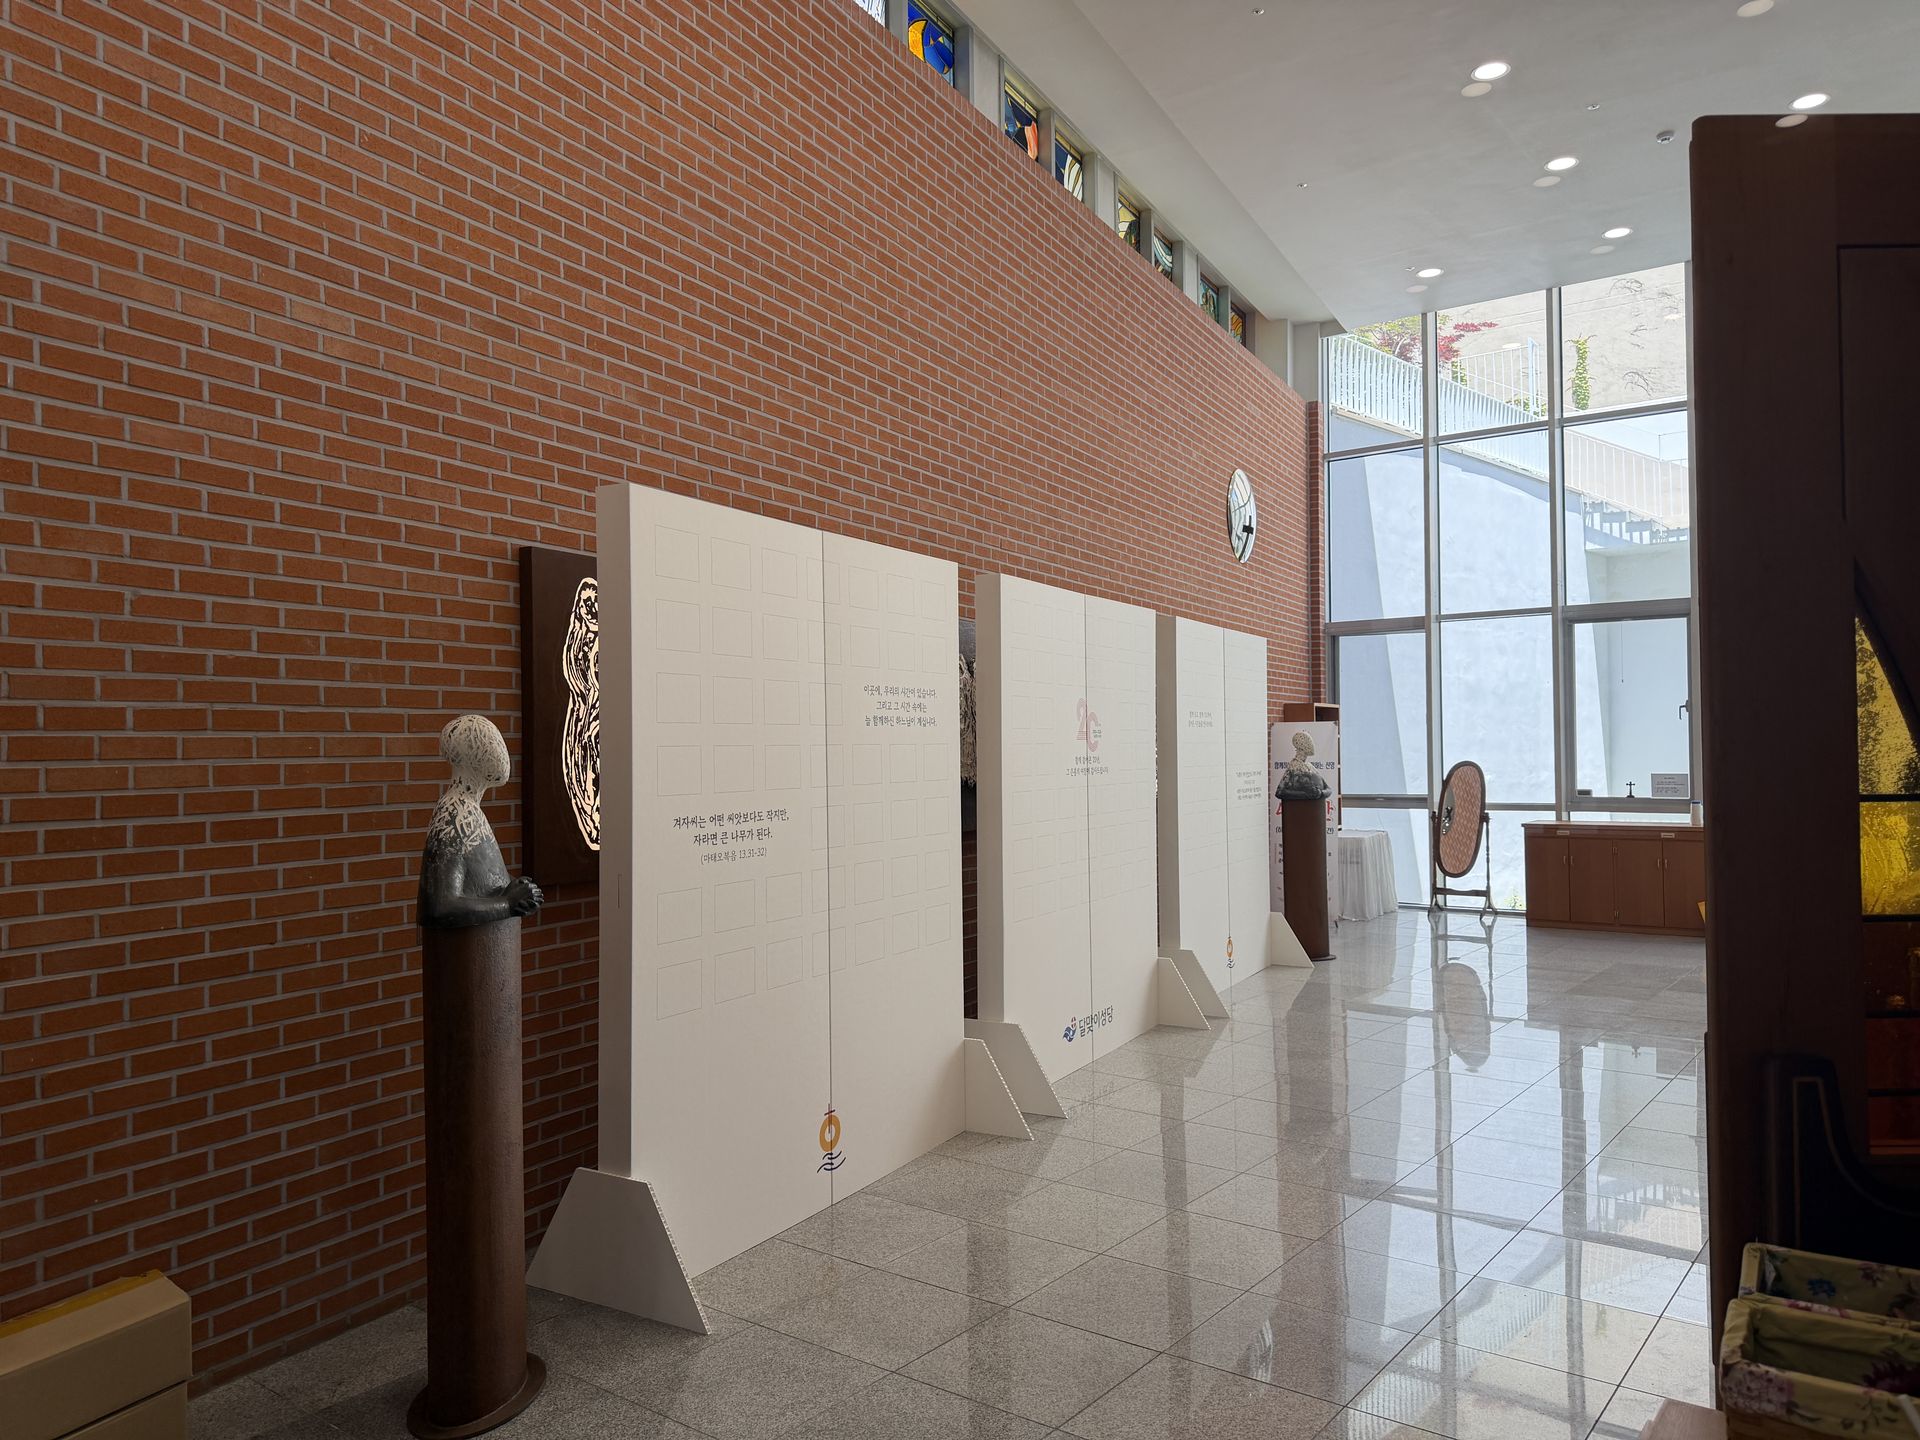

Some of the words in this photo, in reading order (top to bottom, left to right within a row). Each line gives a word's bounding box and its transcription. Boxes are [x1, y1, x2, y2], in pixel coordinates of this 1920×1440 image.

[884, 685, 900, 697] 우리의
[901, 686, 916, 698] 시간이
[876, 700, 893, 711] 그리고
[893, 701, 900, 711] 그
[900, 701, 911, 713] 시간
[911, 701, 928, 713] 속에는
[865, 714, 871, 727] 늘
[895, 715, 916, 727] 하느님이
[673, 815, 707, 829] 겨자씨는
[709, 813, 725, 827] 어떤
[727, 810, 765, 825] 씨앗보다도
[766, 808, 790, 821] 작지만,
[693, 831, 718, 846] 자라면
[720, 831, 729, 845] 큰
[731, 828, 754, 842] 나무가
[756, 826, 773, 841] 된다.
[700, 849, 737, 866] (마태오복음
[1078, 1004, 1113, 1038] 달맞이성당
